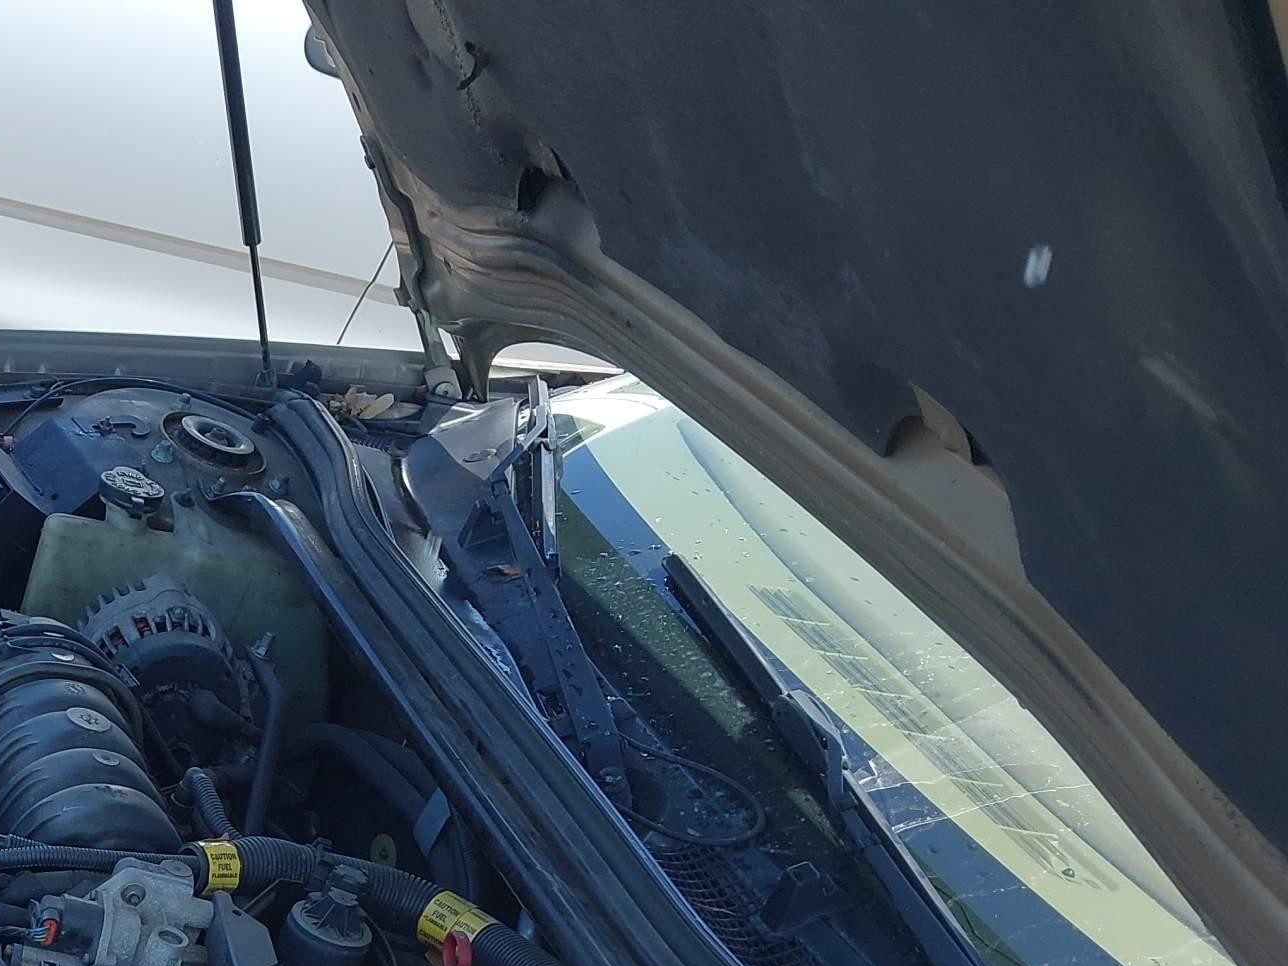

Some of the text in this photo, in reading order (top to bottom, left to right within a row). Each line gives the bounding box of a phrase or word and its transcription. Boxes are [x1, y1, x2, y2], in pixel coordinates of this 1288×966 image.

[210, 852, 237, 861] CAUTION
[218, 863, 233, 871] FUEL
[434, 898, 460, 917] CAUTION
[432, 910, 447, 923] FUEL
